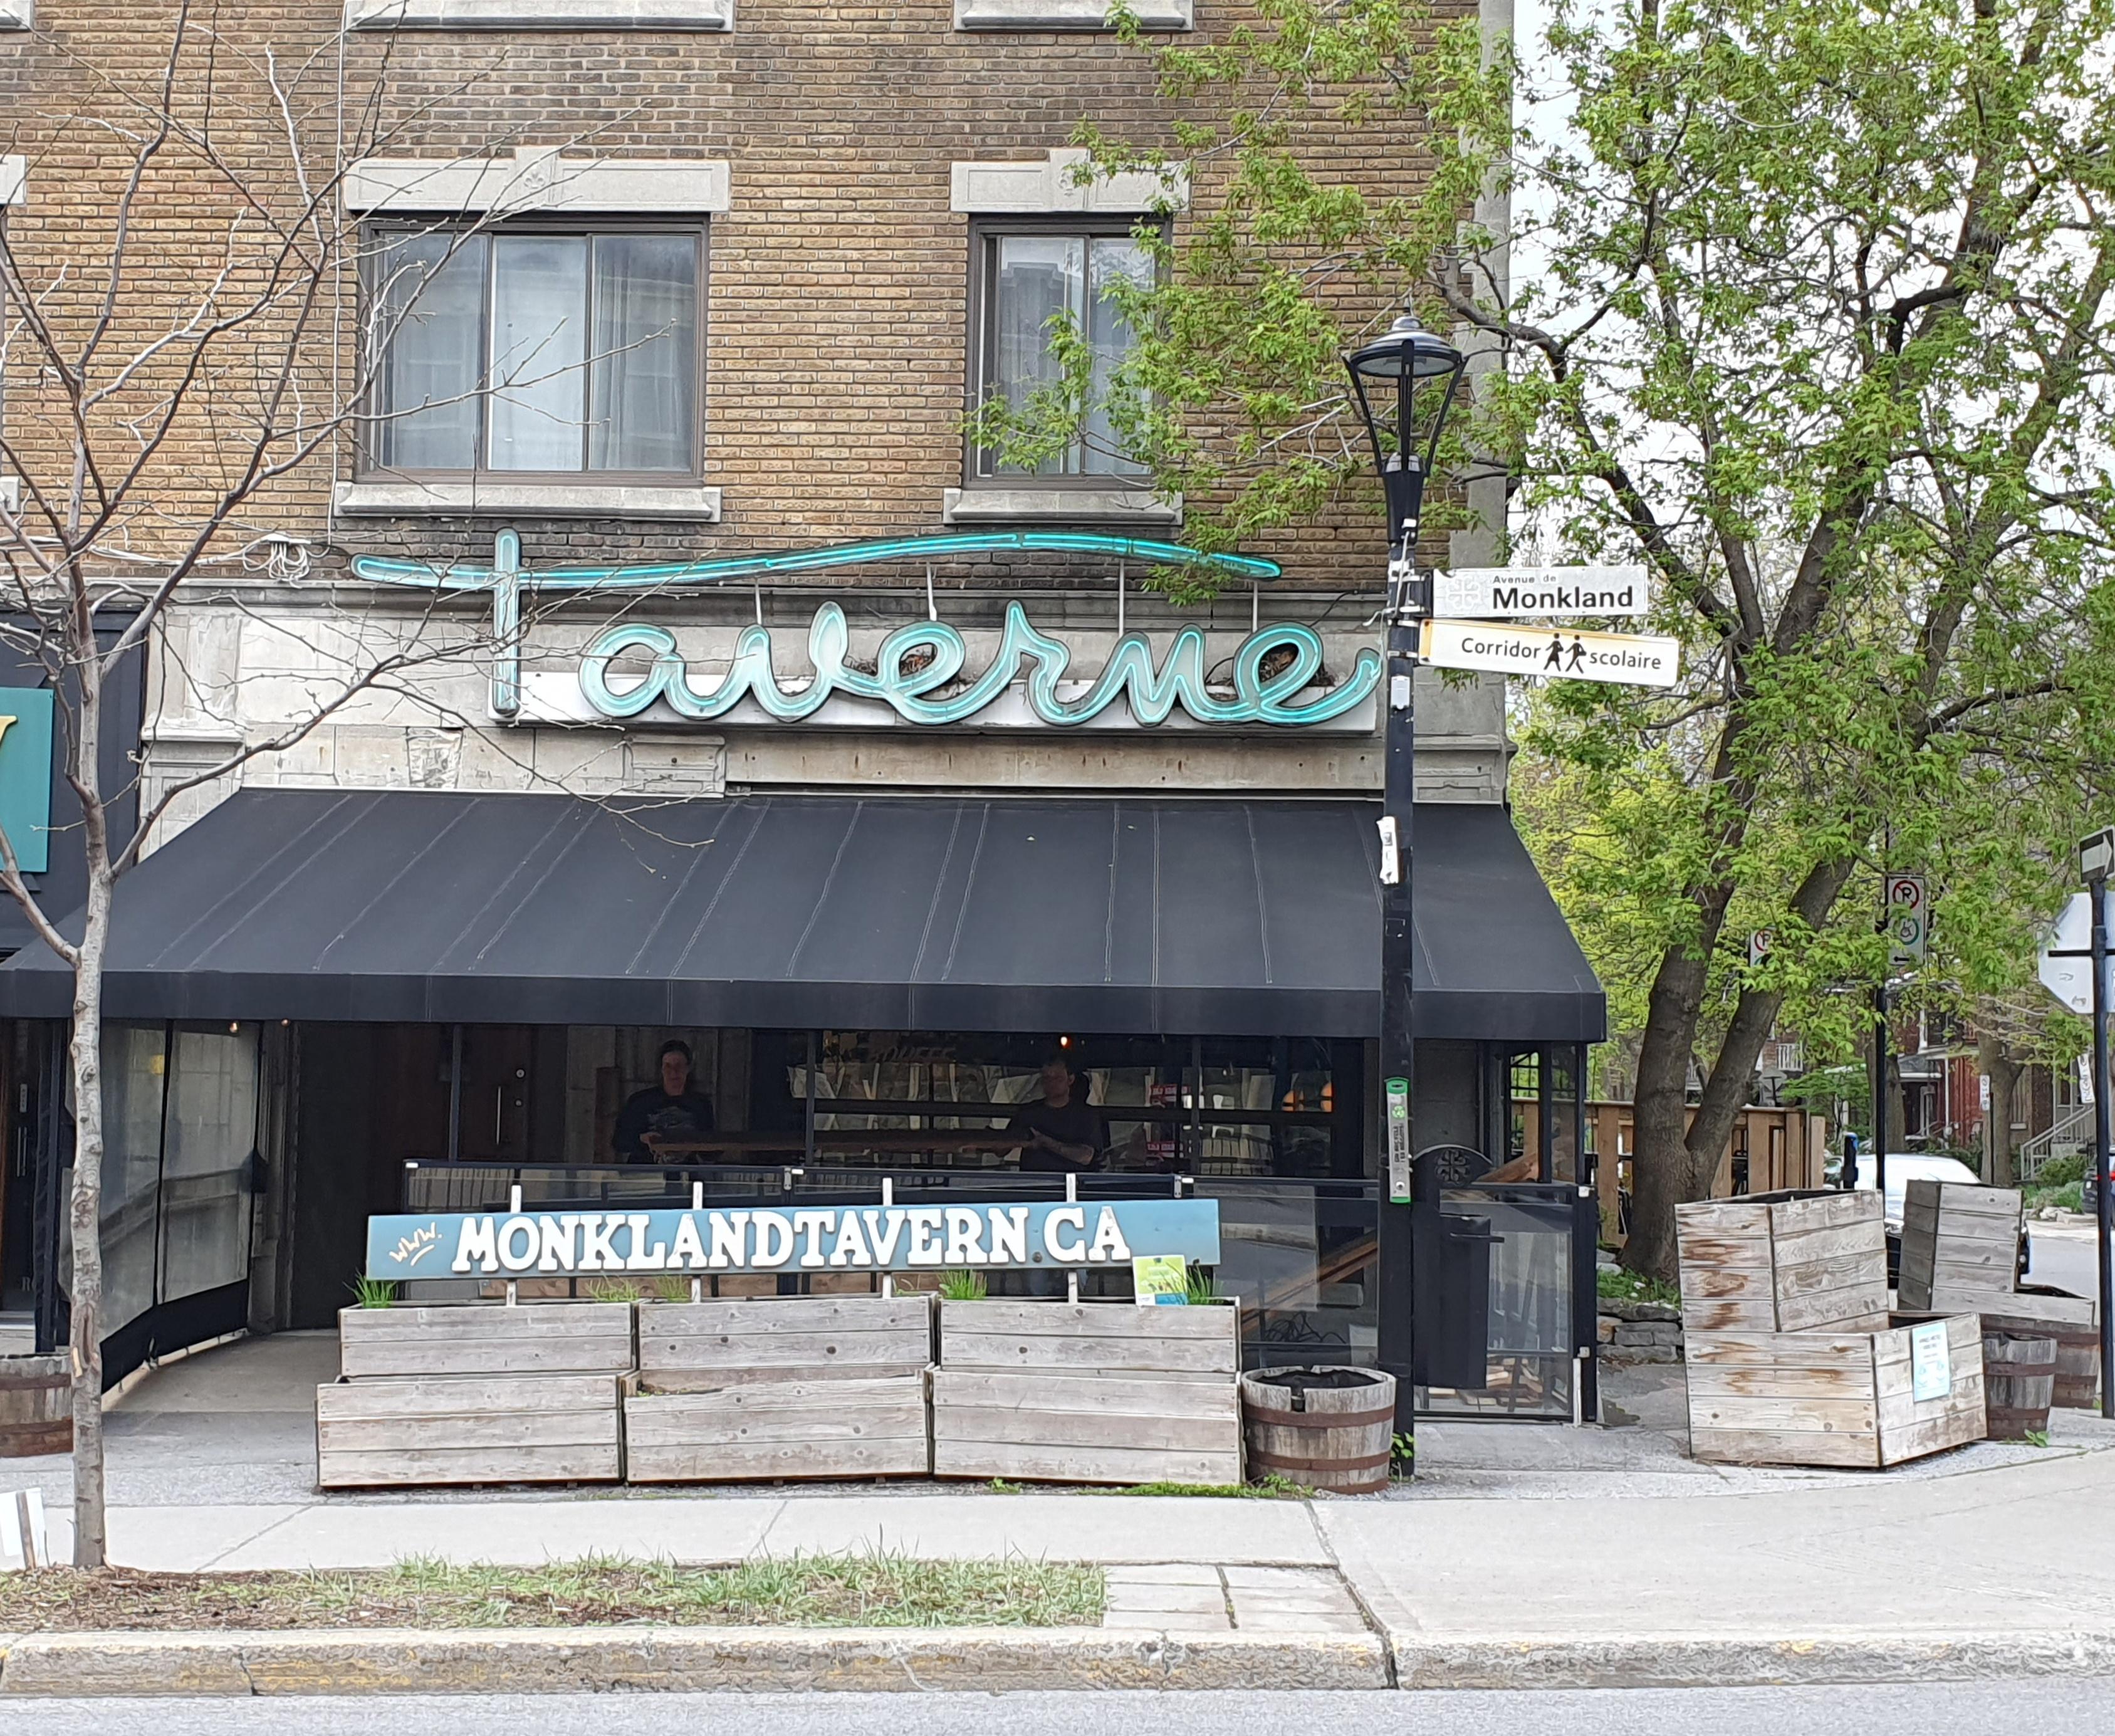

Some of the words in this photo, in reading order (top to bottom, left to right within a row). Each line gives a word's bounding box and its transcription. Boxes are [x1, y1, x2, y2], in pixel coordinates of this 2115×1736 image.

[1493, 575, 1535, 584] Avenue
[1543, 573, 1557, 583] de
[1493, 585, 1633, 609] Monkland
[1461, 637, 1542, 659] Corridor
[1589, 650, 1662, 670] scolaire
